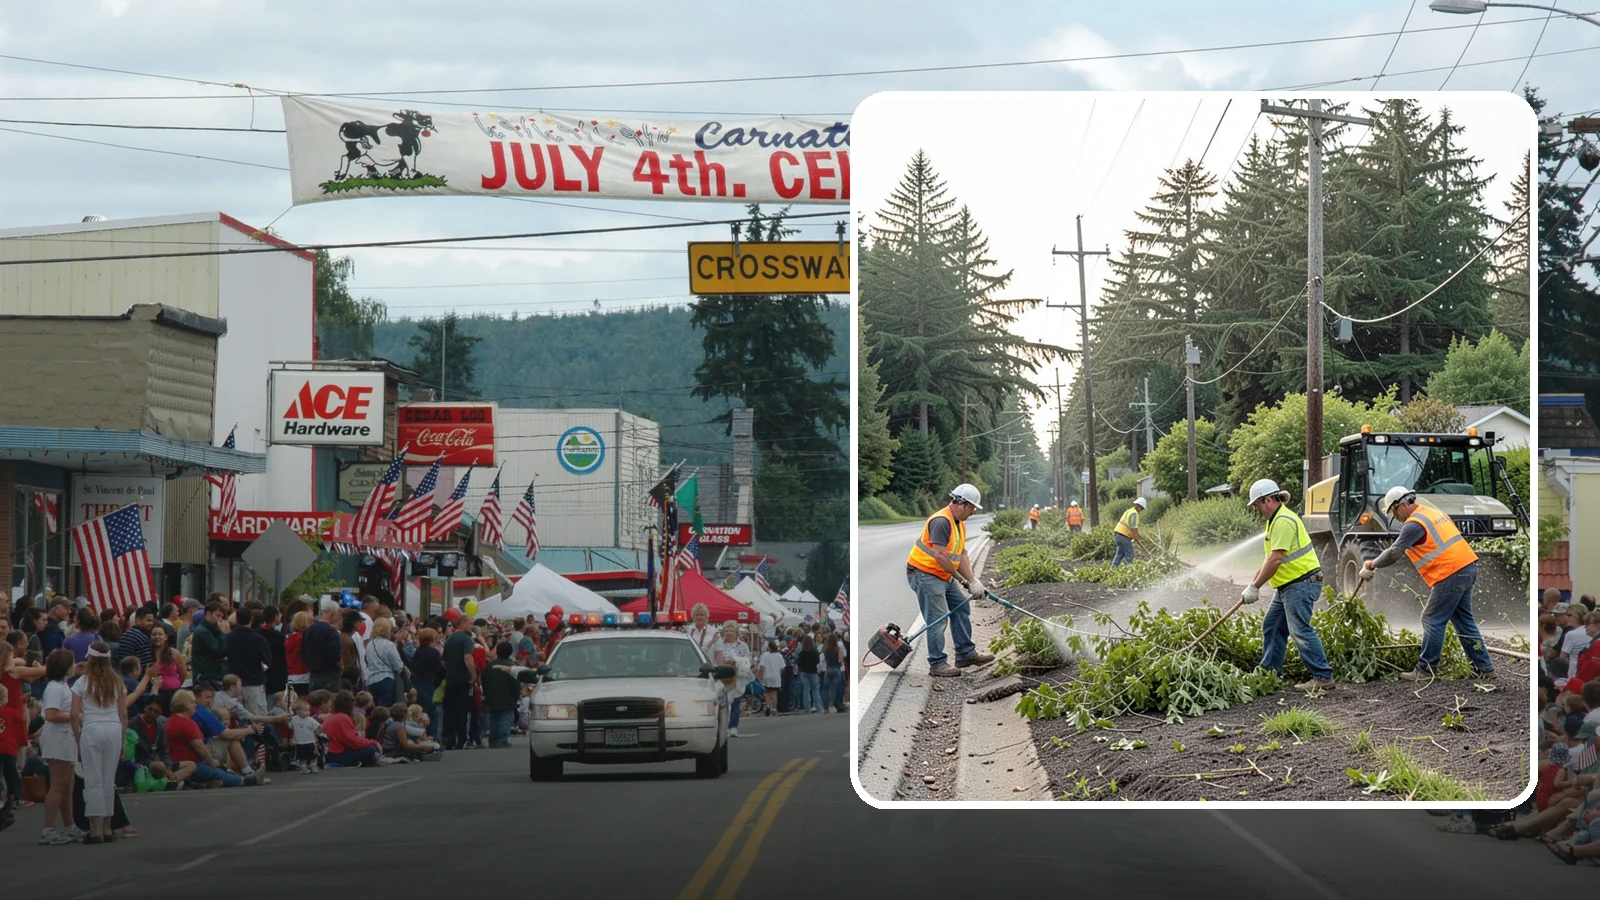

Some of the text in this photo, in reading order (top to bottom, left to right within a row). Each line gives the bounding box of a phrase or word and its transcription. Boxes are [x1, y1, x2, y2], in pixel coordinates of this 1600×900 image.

[481, 141, 604, 192] JULY
[632, 150, 746, 197] 4th.
[697, 254, 850, 280] CROSSWA
[282, 380, 374, 420] ACE
[405, 409, 452, 421] CEDAR
[284, 421, 370, 436] Hardware
[417, 428, 477, 447] Coca-Cola
[84, 485, 155, 495] St. Vincent de Paul
[688, 526, 741, 535] CRNATION
[699, 535, 730, 543] GLASS
